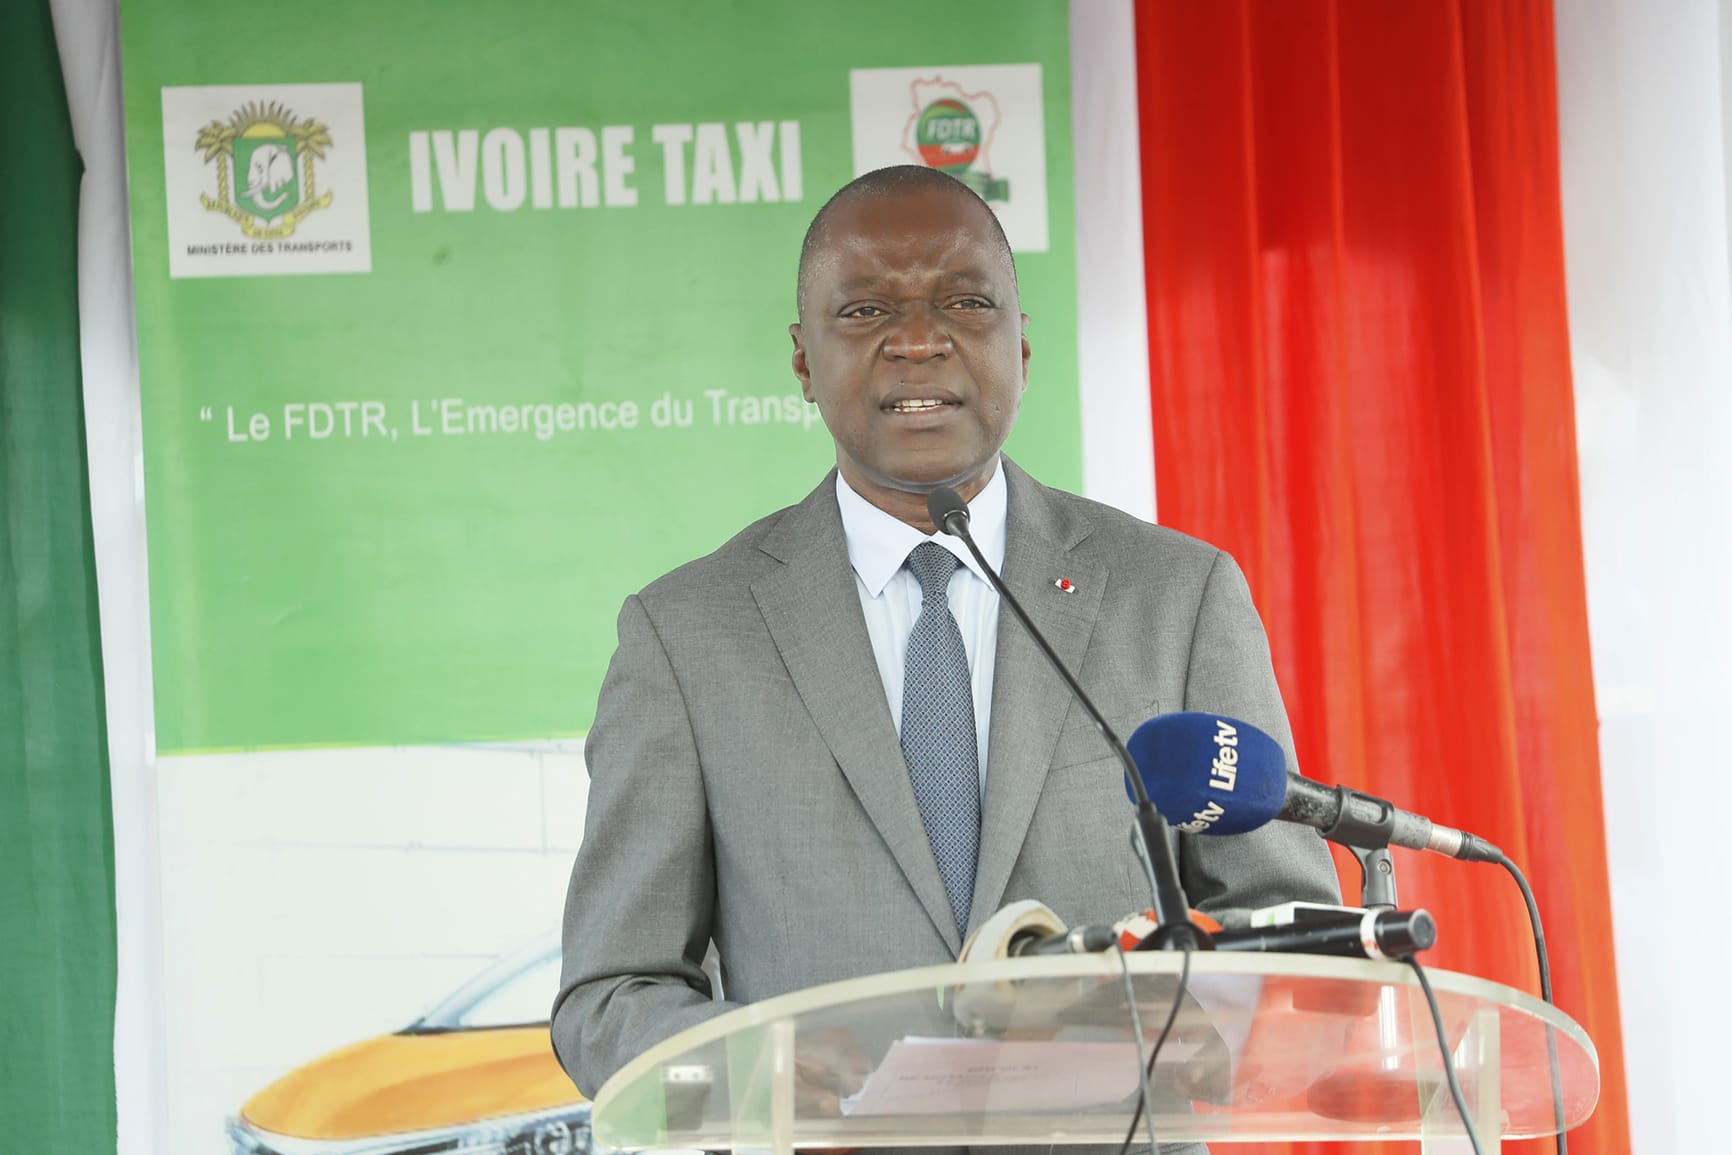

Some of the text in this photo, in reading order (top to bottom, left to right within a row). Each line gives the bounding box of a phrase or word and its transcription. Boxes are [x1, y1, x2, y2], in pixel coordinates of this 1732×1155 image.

[409, 120, 803, 213] IVOIRE TAXI
[187, 241, 353, 256] MINISTÈRE DES TRANSPORTS
[227, 405, 270, 442] Le
[284, 401, 398, 441] FDTR,
[412, 398, 639, 440] L'Emergence
[651, 391, 693, 427] du
[704, 389, 821, 429] Transp
